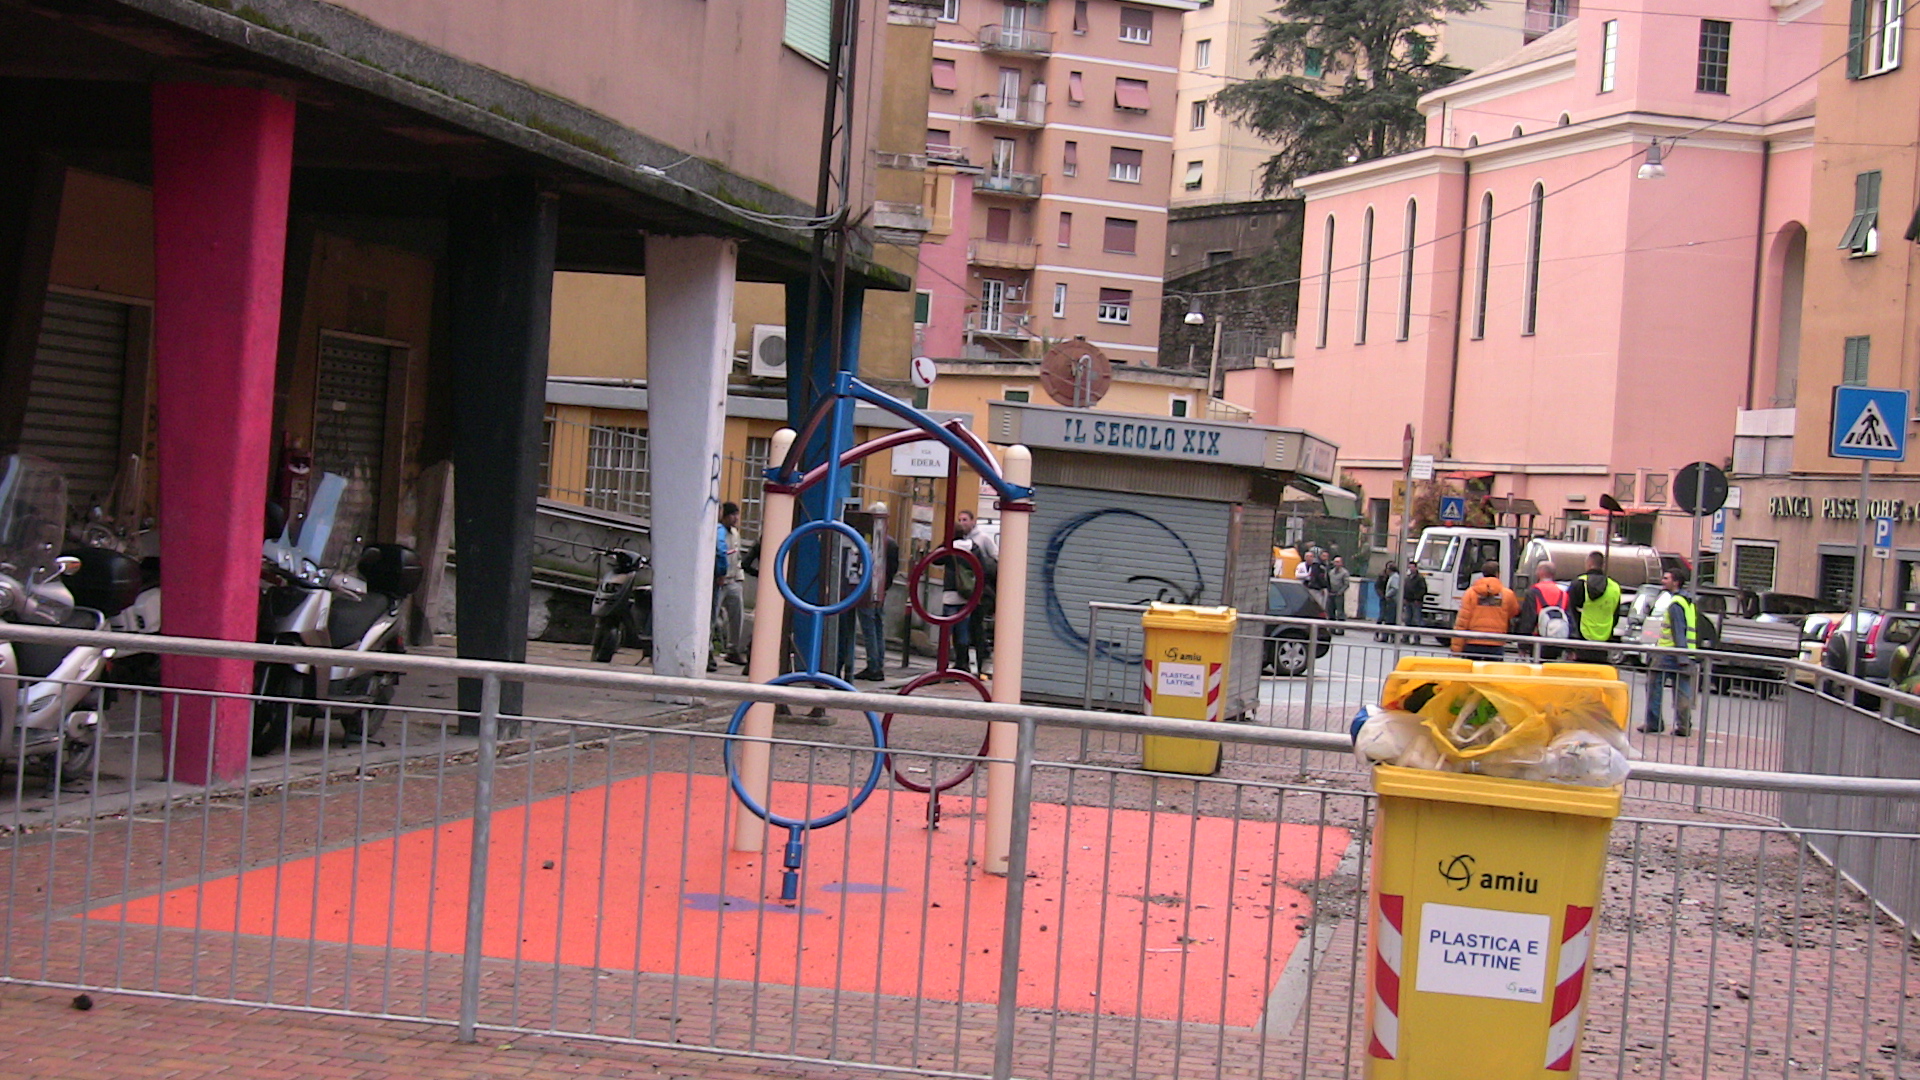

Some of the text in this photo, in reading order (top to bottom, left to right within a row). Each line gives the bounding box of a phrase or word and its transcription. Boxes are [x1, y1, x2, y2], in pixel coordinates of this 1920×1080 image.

[1094, 421, 1175, 451] SECOLO
[1182, 429, 1221, 455] XIX
[911, 458, 941, 467] EDERA
[1768, 496, 1812, 518] BANCA
[1713, 508, 1723, 532] P
[1876, 519, 1888, 545] P
[1180, 653, 1202, 661] amiu
[1161, 672, 1194, 680] PLASTICA
[1166, 679, 1195, 687] LATTINE
[1480, 871, 1538, 894] amiu
[1430, 929, 1539, 955] PLASTICA E
[1443, 949, 1522, 972] LATTINE
